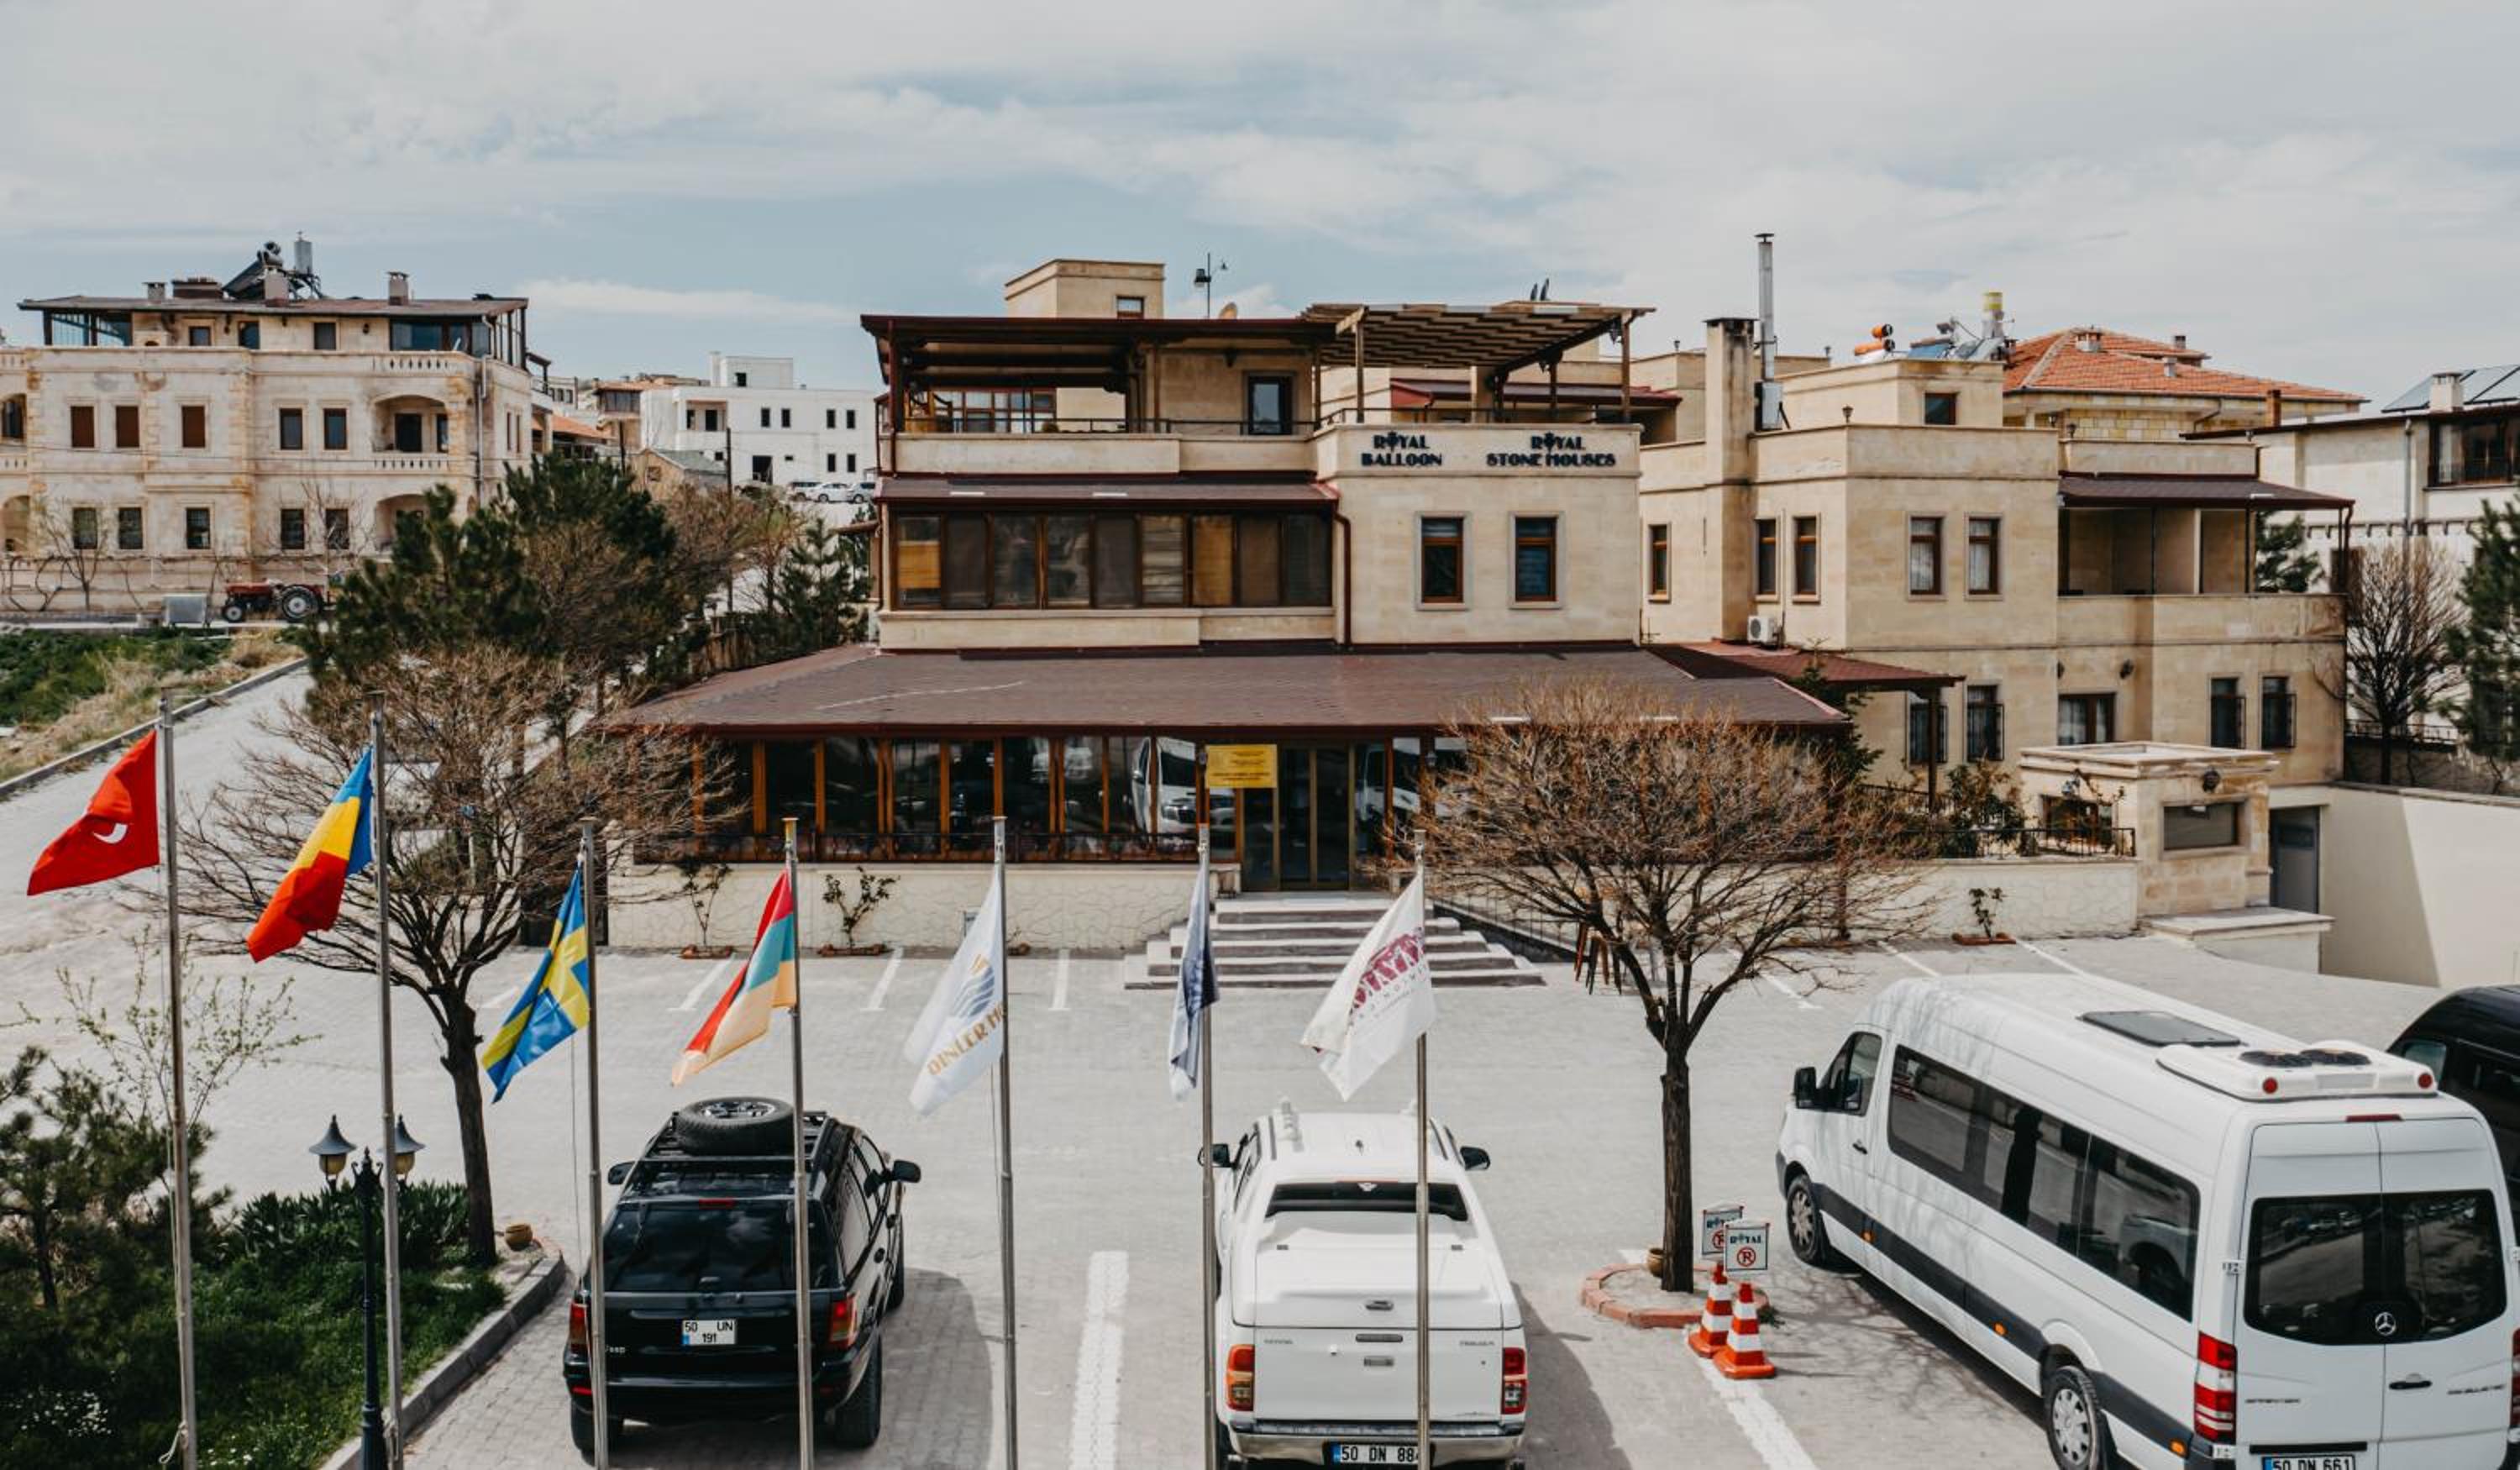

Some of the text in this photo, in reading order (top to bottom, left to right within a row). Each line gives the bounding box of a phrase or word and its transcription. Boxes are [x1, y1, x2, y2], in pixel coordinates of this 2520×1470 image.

[1373, 431, 1430, 452] ROYAL
[1531, 432, 1586, 452] ROYAL
[1361, 453, 1442, 466] BALLOON
[1486, 453, 1615, 467] STONE HOUSES
[685, 1321, 733, 1332] 50 UN
[702, 1333, 717, 1342] 191
[1342, 1446, 1418, 1462] 50 DN 88
[2323, 1458, 2349, 1470] 661
